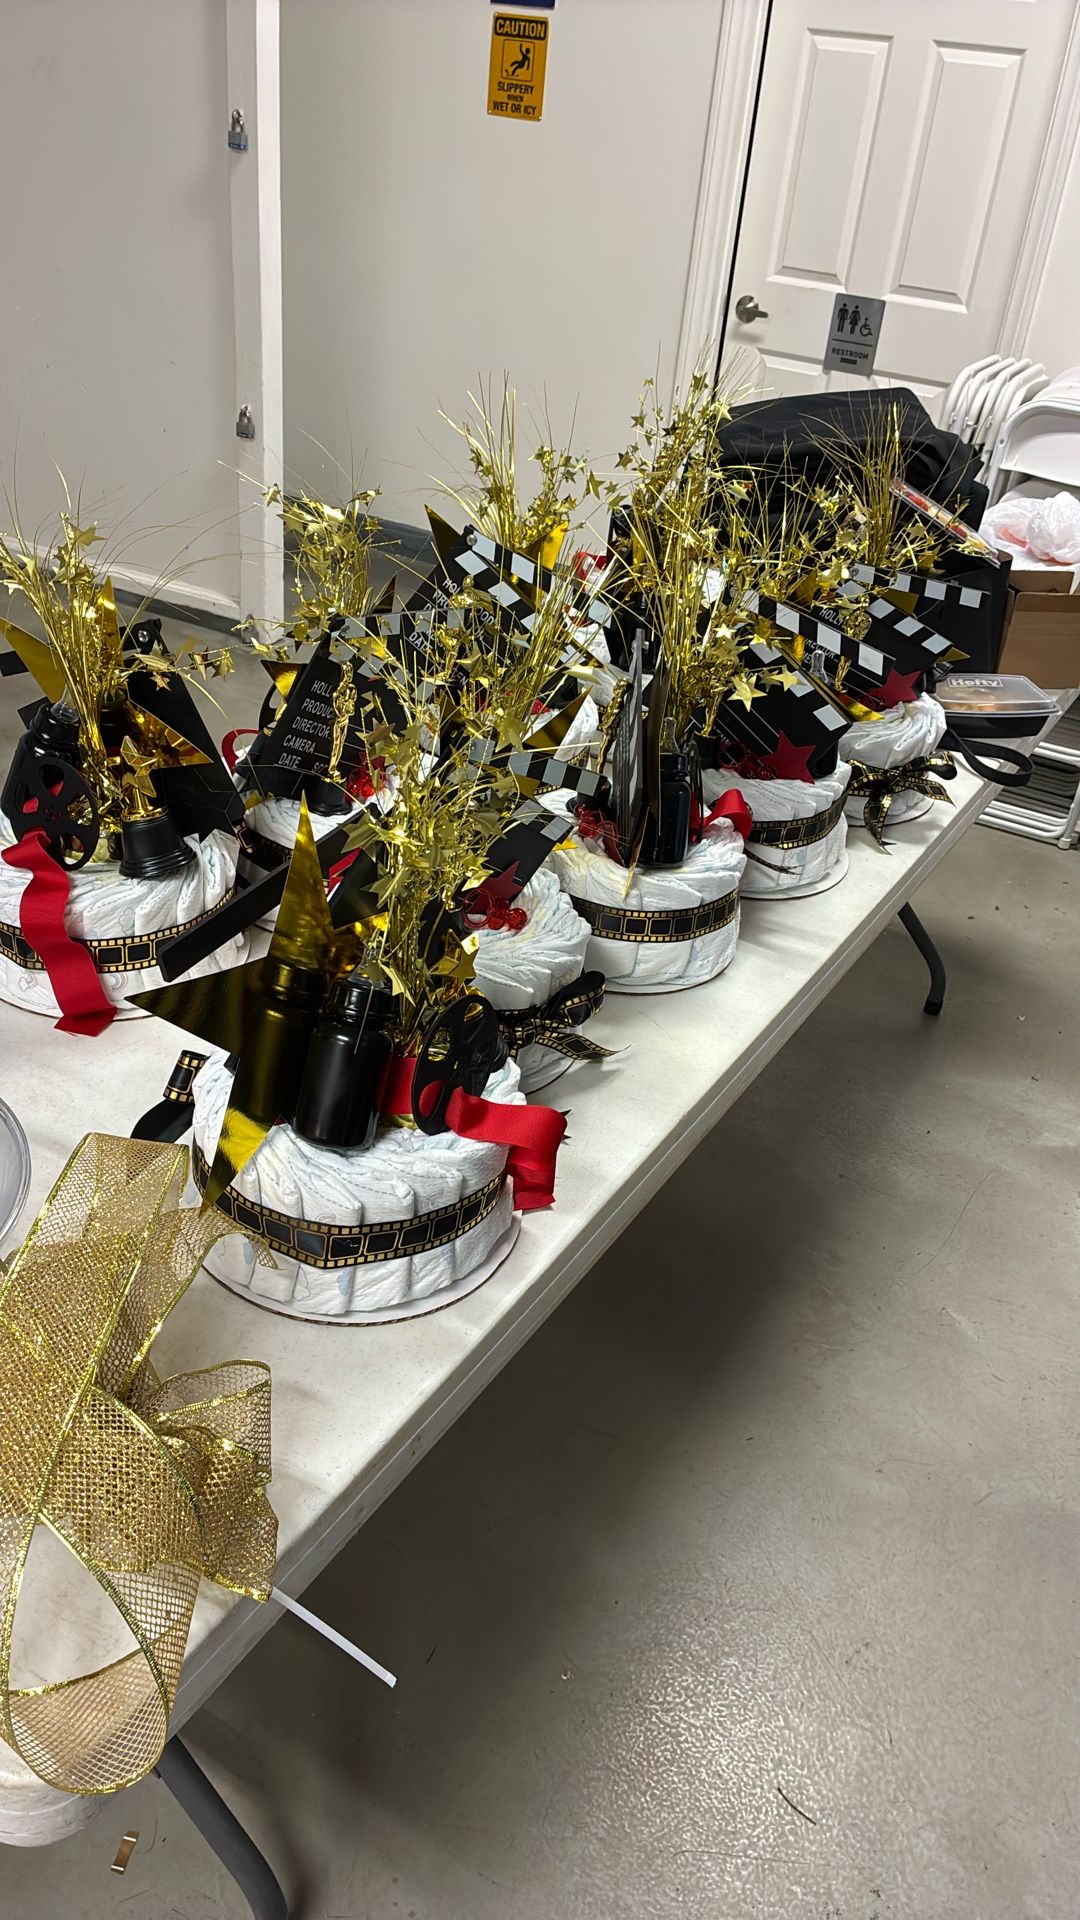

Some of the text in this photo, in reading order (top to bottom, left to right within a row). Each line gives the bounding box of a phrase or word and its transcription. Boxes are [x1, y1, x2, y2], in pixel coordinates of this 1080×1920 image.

[496, 19, 546, 38] CAUTION
[497, 81, 534, 95] SLIPPERY
[493, 101, 536, 115] WET OR ICY
[831, 347, 869, 359] RESTROOM
[311, 680, 333, 697] HOLL
[951, 678, 998, 686] Hefty
[301, 698, 334, 719] PRODUC
[283, 734, 316, 754] CAMERA
[278, 753, 301, 769] DATE
